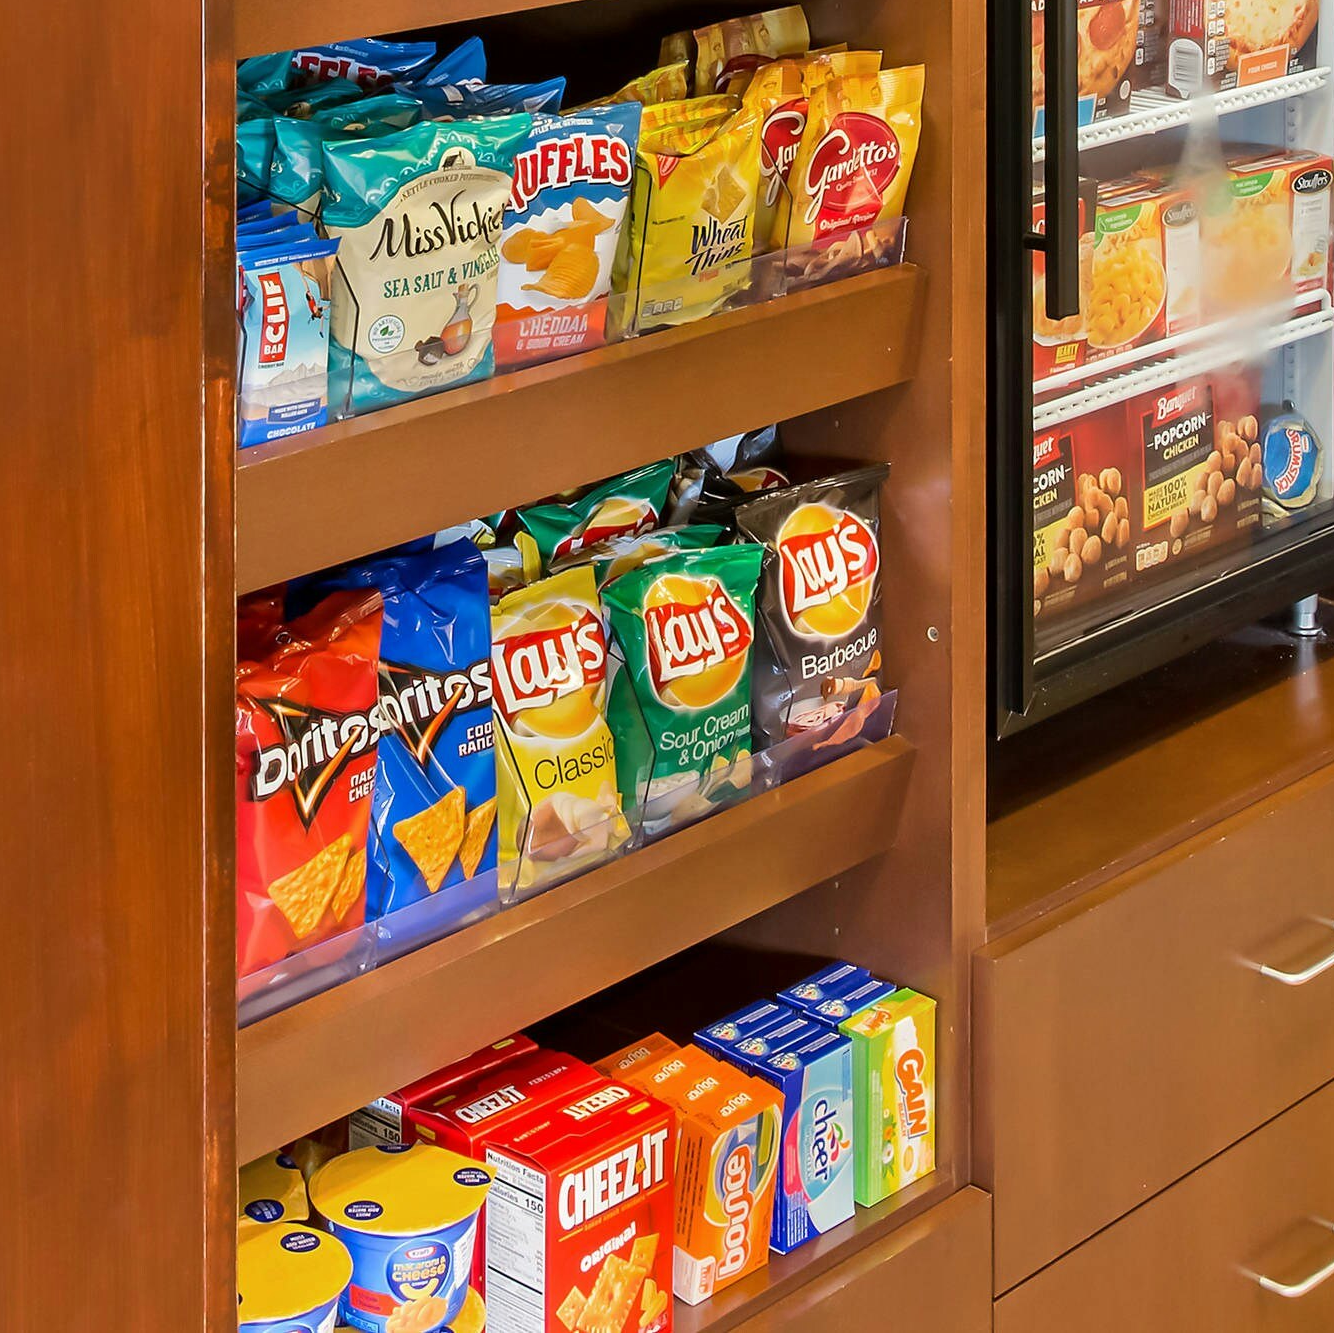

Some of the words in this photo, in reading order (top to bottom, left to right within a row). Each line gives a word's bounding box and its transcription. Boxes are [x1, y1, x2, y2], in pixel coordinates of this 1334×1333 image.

[401, 179, 428, 201] KETTLE
[804, 129, 898, 226] Gardetto's
[369, 213, 445, 261] Miss
[691, 215, 748, 255] Wheat
[685, 242, 746, 276] Thins
[383, 280, 411, 299] SEA
[413, 270, 444, 295] SALT
[447, 266, 457, 284] &
[265, 279, 284, 344] CLIF
[263, 343, 283, 356] BAR
[553, 332, 586, 346] CREAM
[266, 423, 317, 439] CHOCOLATE
[1154, 413, 1207, 450] POPCORN
[1163, 434, 1199, 460] CHICKEN
[1034, 466, 1065, 493] CORN
[1164, 476, 1188, 498] 100%
[1034, 488, 1058, 510] CKEN
[1148, 490, 1188, 512] NATURAL
[790, 519, 868, 613] Lay's
[651, 595, 739, 682] Lay's
[802, 628, 878, 680] Barbecue
[492, 616, 605, 713] Lay's
[467, 720, 494, 741] COO
[660, 726, 700, 751] Sour
[703, 704, 749, 737] Cream
[256, 704, 379, 796] Doritos
[459, 734, 495, 757] RANC
[534, 735, 615, 790] Classic
[679, 751, 690, 767] &
[693, 730, 735, 763] Onion
[652, 1059, 686, 1083] bounce
[686, 1076, 719, 1101] bounce
[719, 1092, 753, 1117] bounce
[896, 1049, 929, 1139] GAIN
[382, 1127, 401, 1143] 150
[811, 1098, 837, 1182] cheer
[487, 1151, 521, 1173] Nutrition
[522, 1169, 544, 1185] Facts
[525, 1199, 544, 1214] 150
[718, 1154, 750, 1278] bounce
